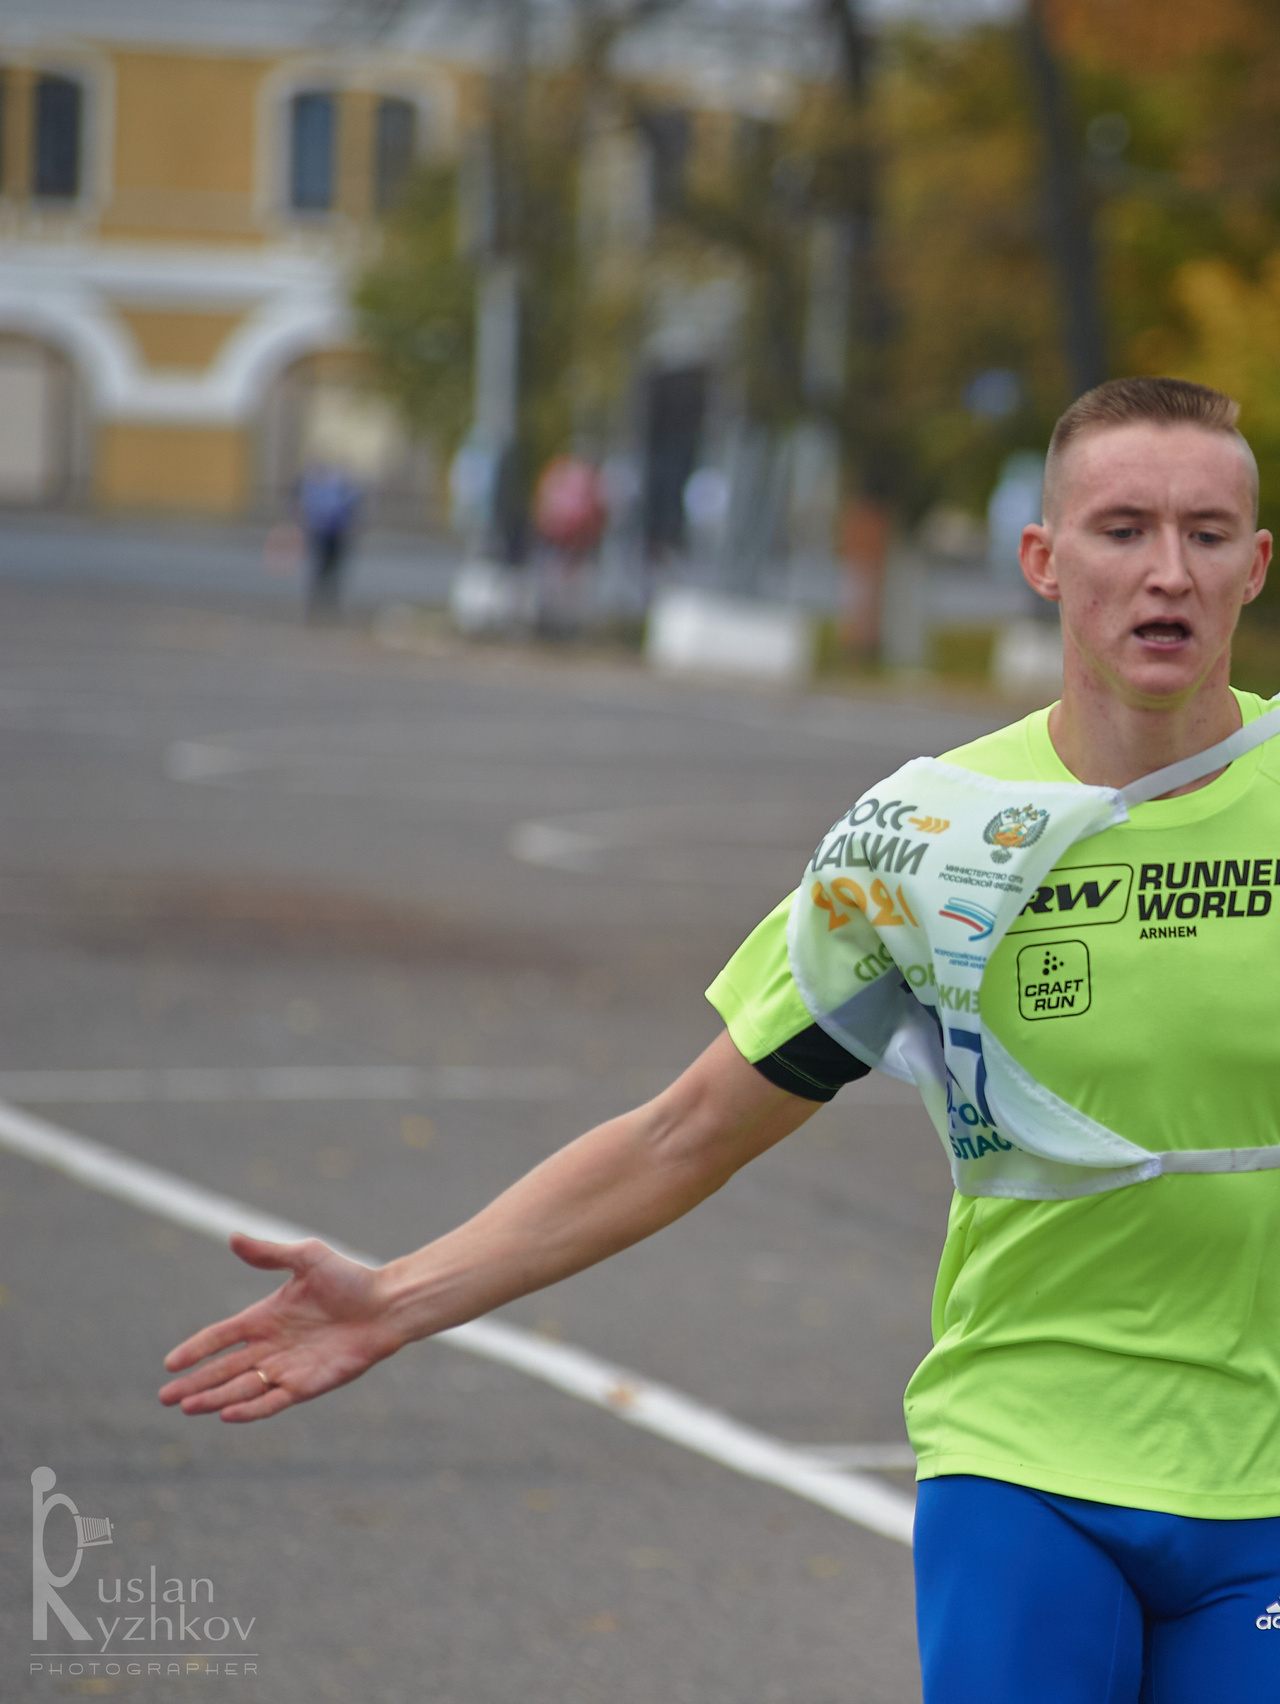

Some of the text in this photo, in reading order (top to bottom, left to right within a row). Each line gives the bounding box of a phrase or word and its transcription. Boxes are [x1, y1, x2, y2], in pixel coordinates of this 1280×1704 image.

[1017, 879, 1122, 916] RW
[1137, 890, 1272, 921] WORLD
[1139, 926, 1197, 939] ARNHEM
[1025, 979, 1083, 997] CRAFT
[1034, 995, 1075, 1012] RUN
